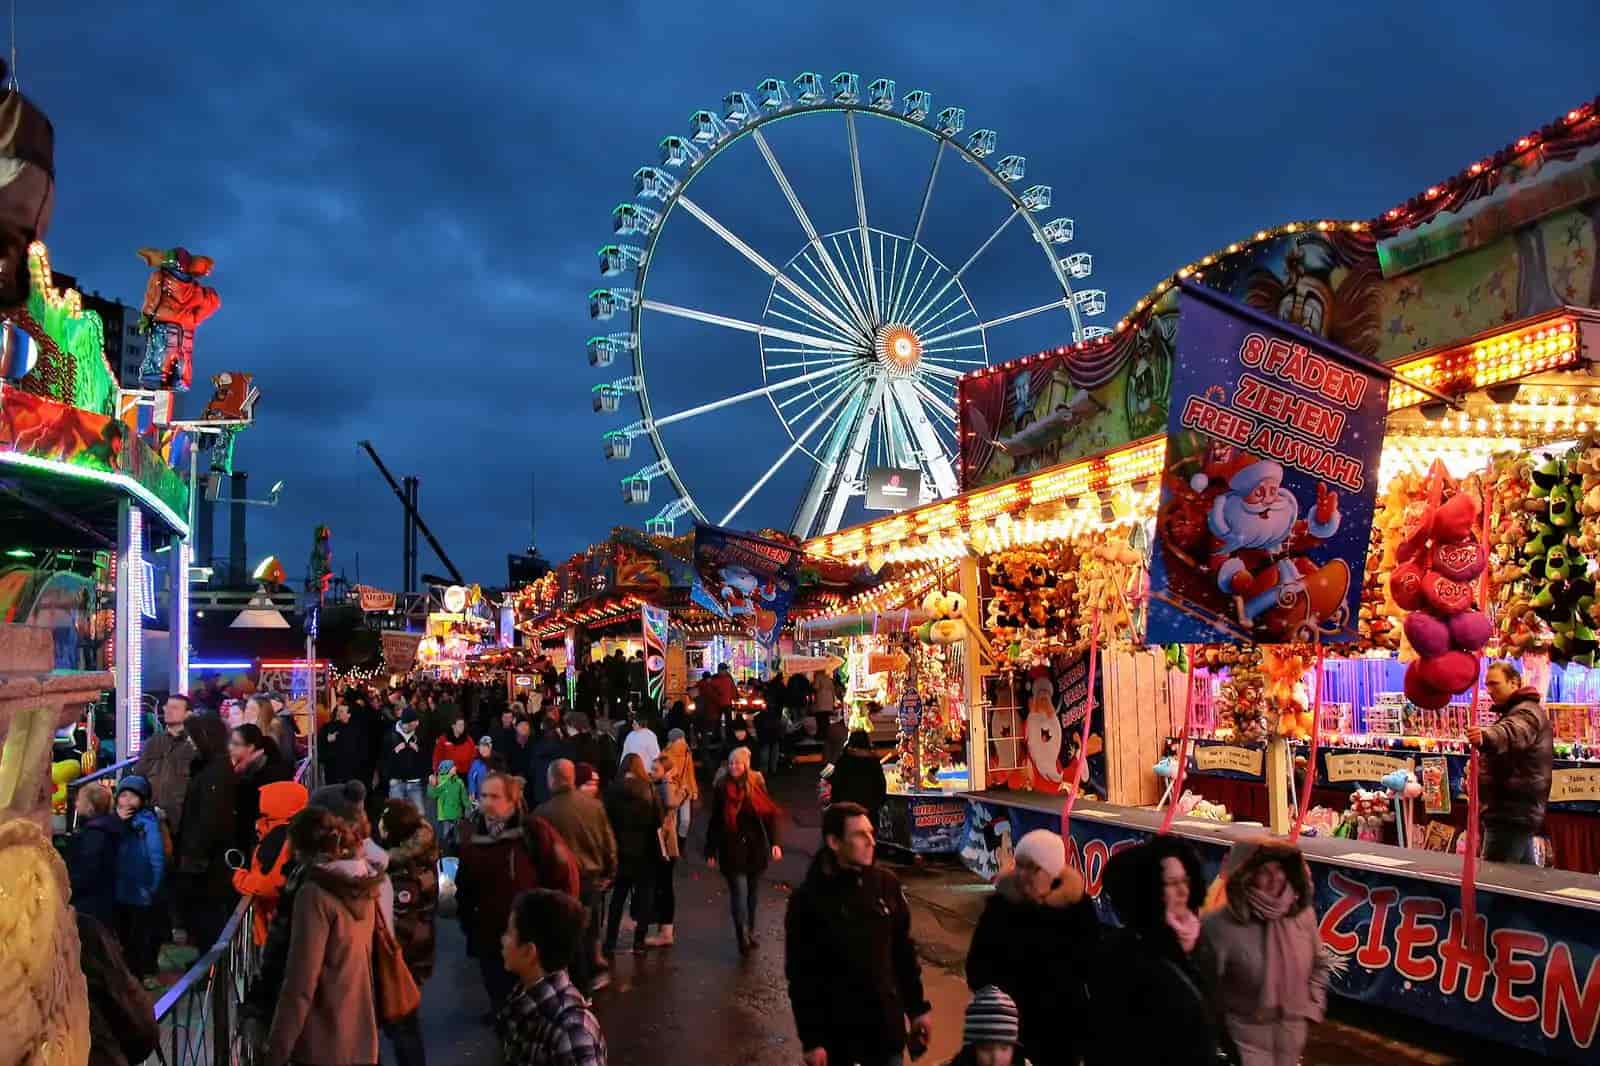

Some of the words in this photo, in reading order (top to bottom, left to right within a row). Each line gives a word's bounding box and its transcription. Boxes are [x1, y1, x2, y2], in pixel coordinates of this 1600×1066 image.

[1234, 374, 1344, 445] ZIEHEN
[1240, 334, 1265, 367] 8
[1262, 338, 1366, 408] FÄDEN
[1182, 396, 1255, 445] FREIE
[1251, 425, 1364, 491] AUSWAHL
[1318, 871, 1600, 1048] ZIEHEN
